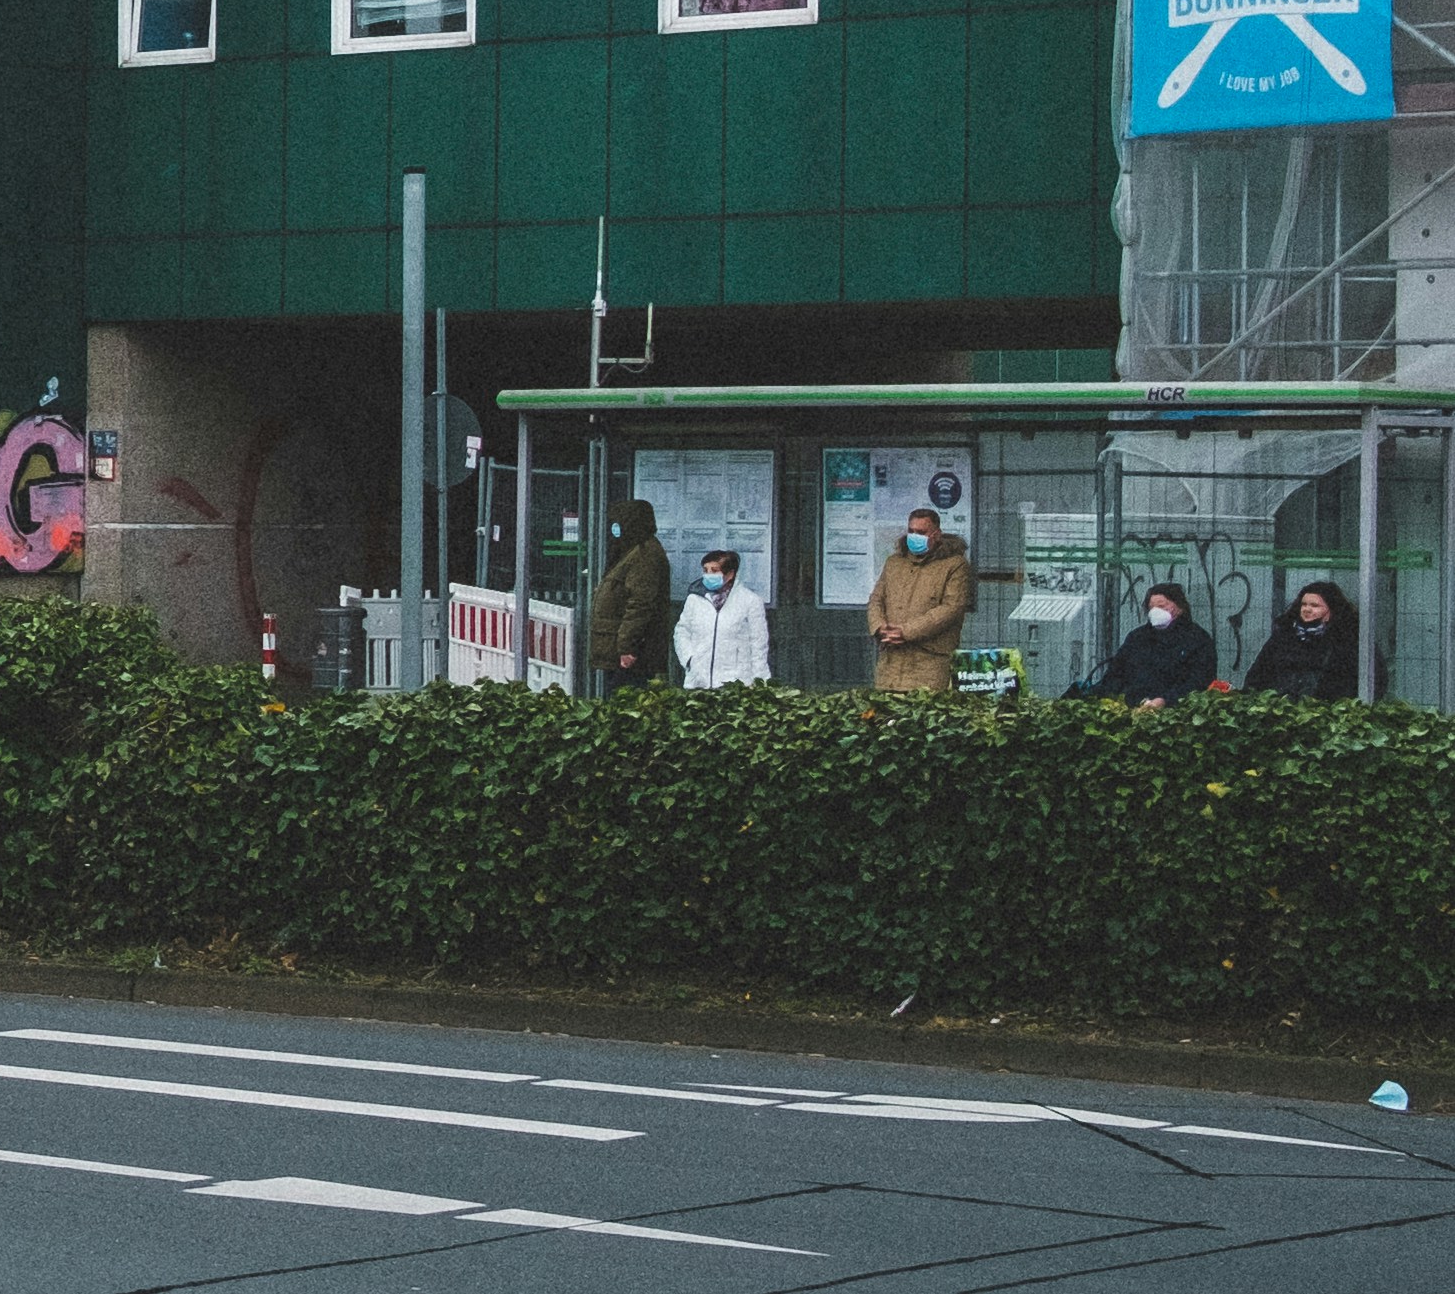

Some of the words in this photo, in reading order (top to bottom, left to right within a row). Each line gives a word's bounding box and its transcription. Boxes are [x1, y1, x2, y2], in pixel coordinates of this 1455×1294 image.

[1227, 74, 1255, 92] LOVE
[1259, 76, 1275, 92] MY
[1280, 67, 1300, 88] JOB
[1148, 387, 1185, 401] HCR
